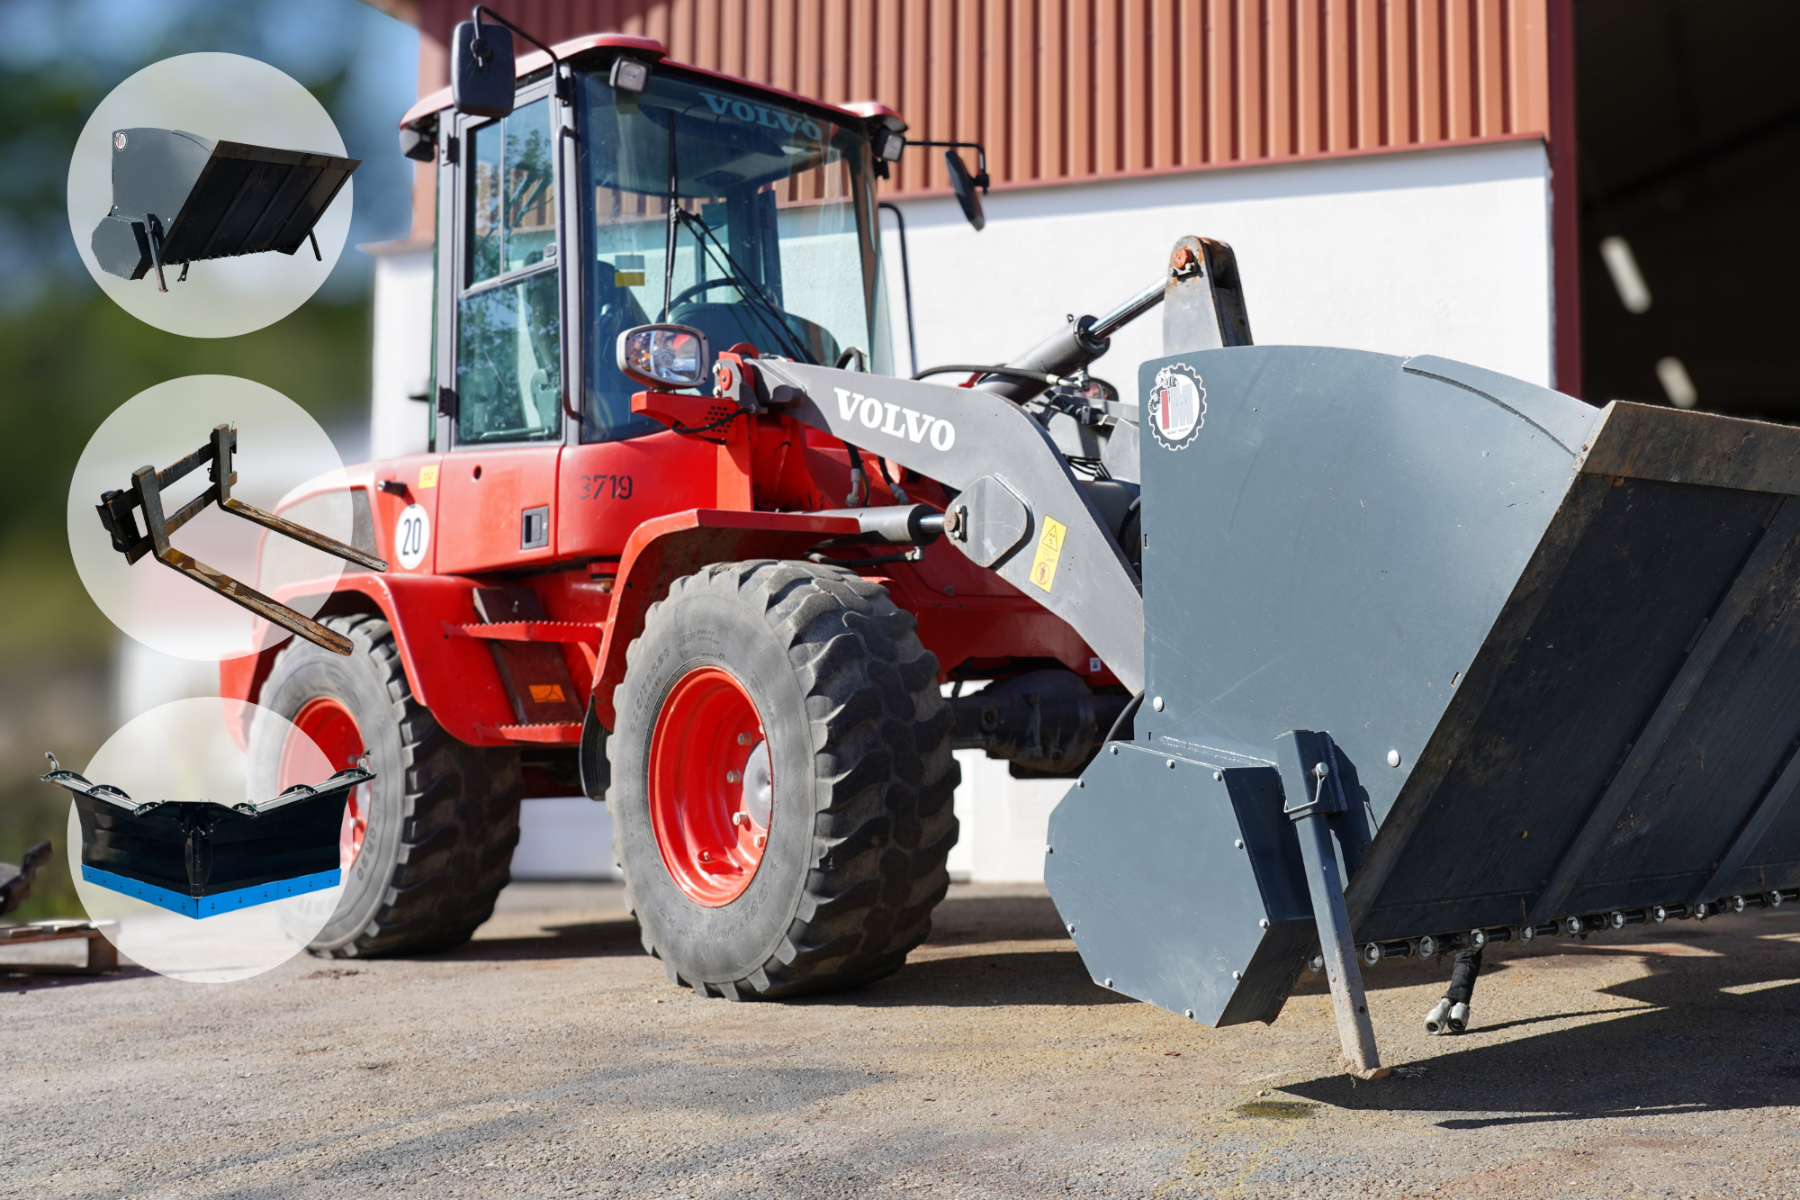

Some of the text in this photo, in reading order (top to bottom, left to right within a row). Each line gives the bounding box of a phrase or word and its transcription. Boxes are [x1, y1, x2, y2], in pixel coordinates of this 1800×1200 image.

[699, 92, 822, 140] VOLVO
[834, 387, 956, 451] VOLVO
[578, 474, 633, 500] 3719
[402, 517, 422, 556] 20
